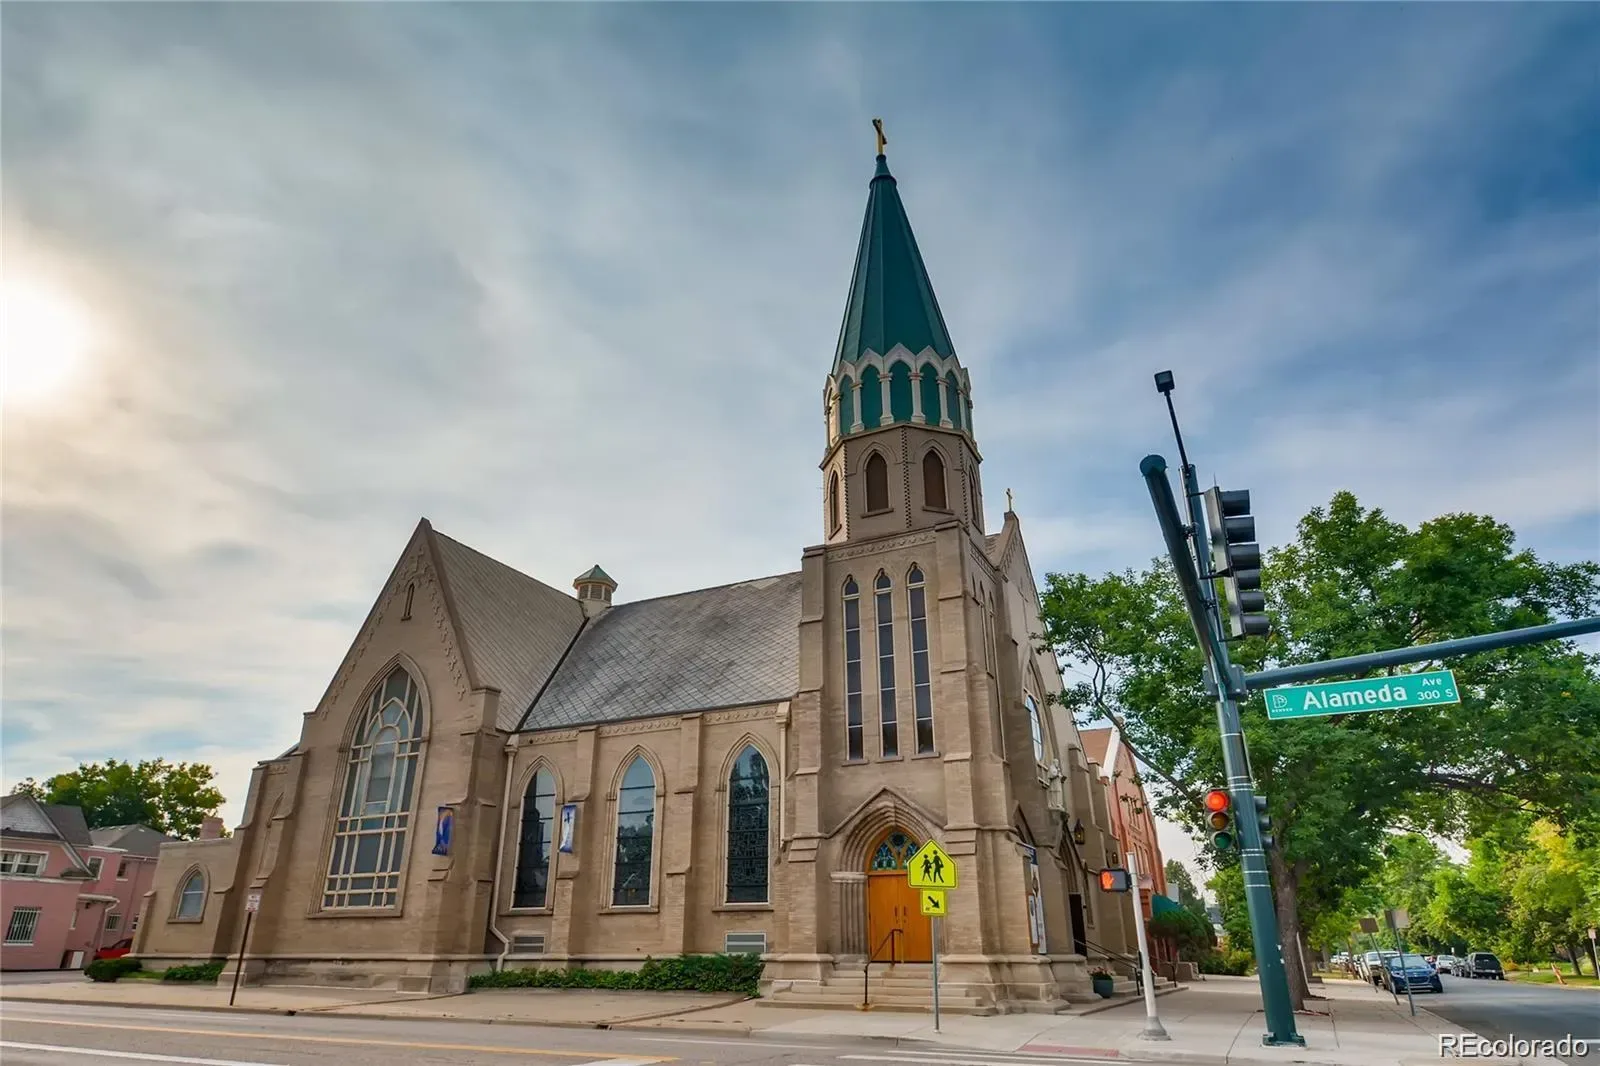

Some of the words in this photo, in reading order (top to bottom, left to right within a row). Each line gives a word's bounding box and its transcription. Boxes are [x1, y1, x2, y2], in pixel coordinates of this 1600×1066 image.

[1422, 678, 1442, 687] Ave
[1303, 684, 1408, 710] Alameda
[1416, 689, 1440, 701] 300
[1445, 688, 1454, 698] S
